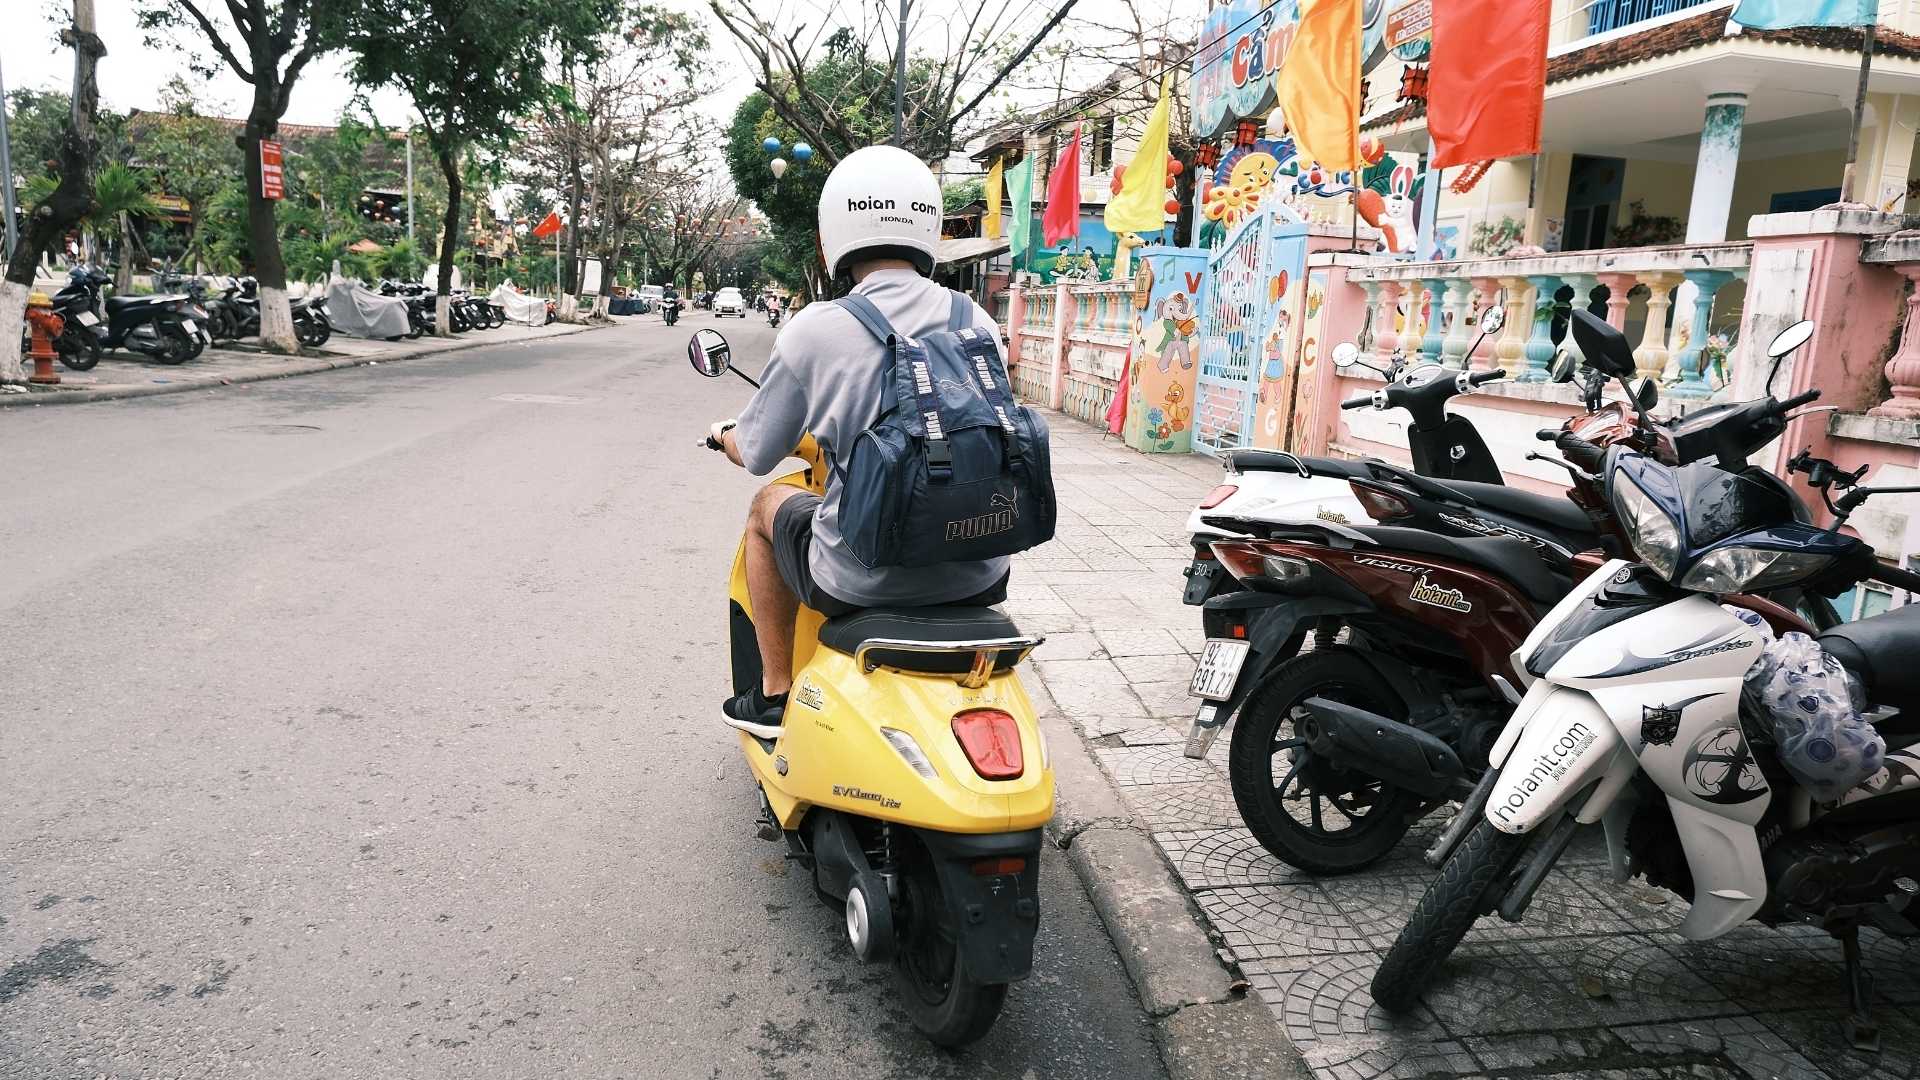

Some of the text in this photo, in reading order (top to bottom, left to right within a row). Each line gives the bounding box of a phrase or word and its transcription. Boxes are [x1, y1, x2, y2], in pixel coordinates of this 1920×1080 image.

[847, 195, 937, 216] hoian com
[880, 215, 914, 225] HONDA
[1184, 271, 1203, 294] V
[911, 361, 933, 395] PUMA
[972, 355, 997, 390] PUMA
[945, 509, 1011, 541] PUMA
[1353, 555, 1434, 576] VISION
[1494, 722, 1589, 822] hoianit.com
